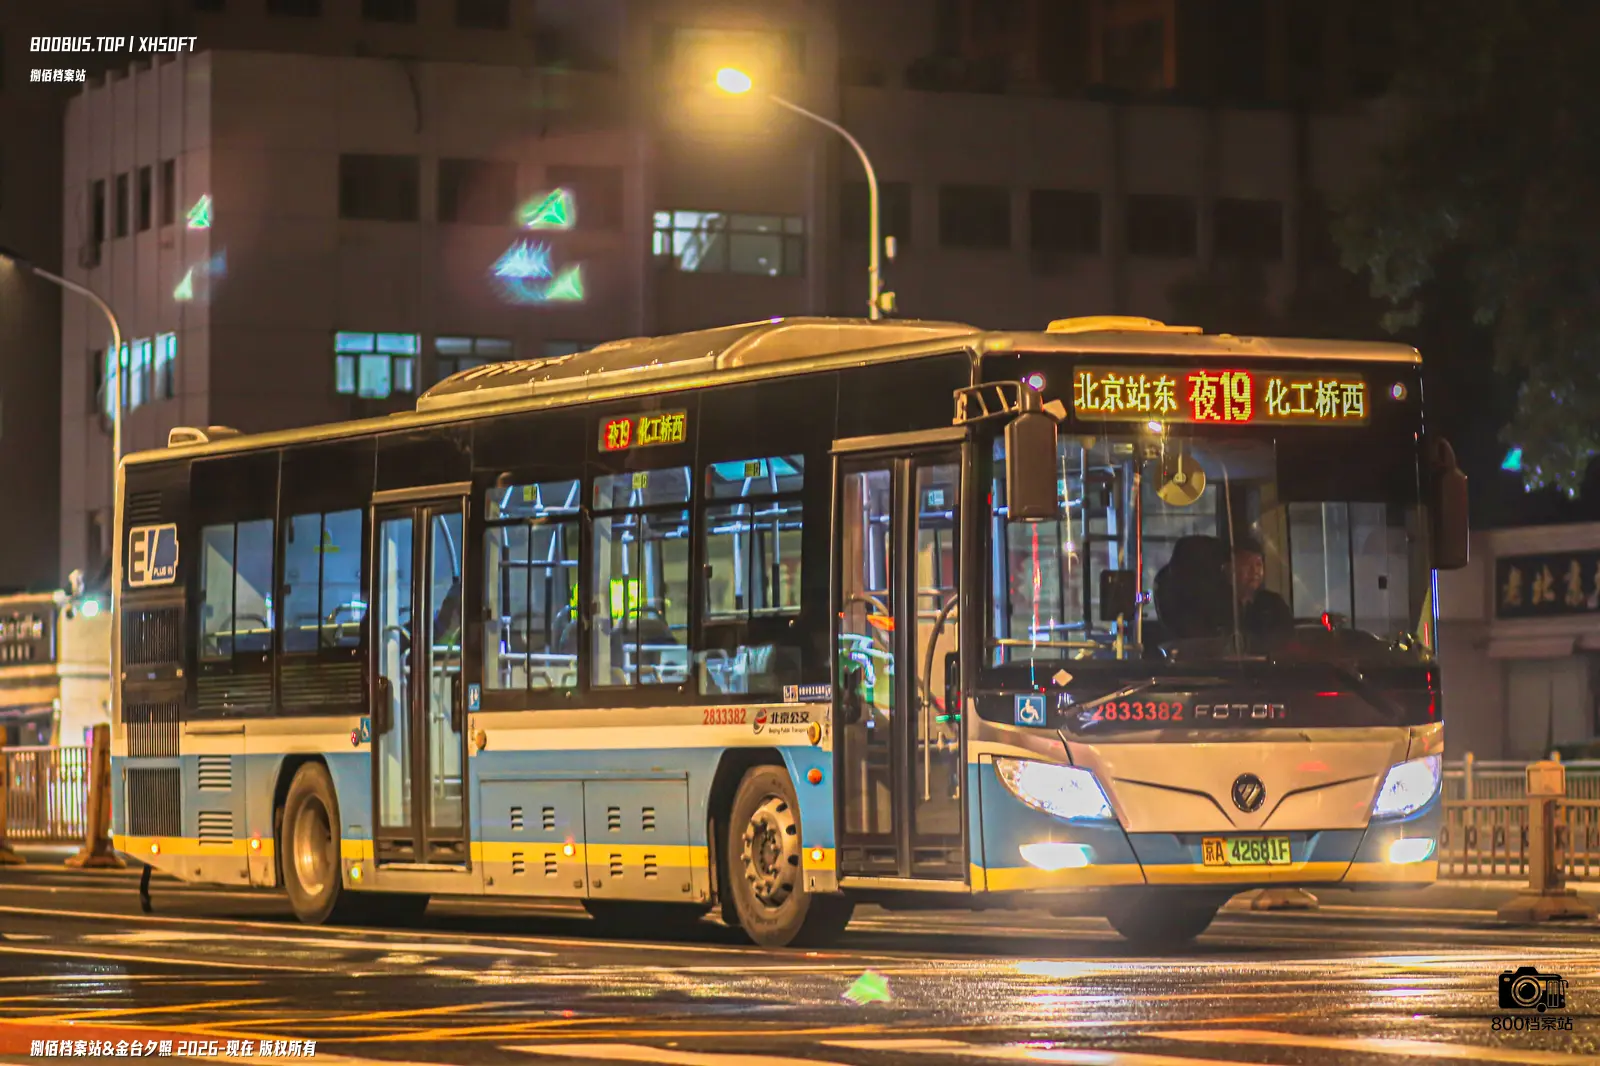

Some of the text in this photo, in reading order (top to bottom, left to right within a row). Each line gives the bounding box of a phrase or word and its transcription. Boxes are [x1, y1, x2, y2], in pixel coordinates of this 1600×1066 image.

[1074, 371, 1364, 421] 北京站东 夜19 化工桥西
[607, 414, 684, 448] 夜19 化工桥西
[703, 708, 746, 725] 2833382
[769, 711, 810, 725] 北京公交
[1091, 701, 1183, 721] 2833382
